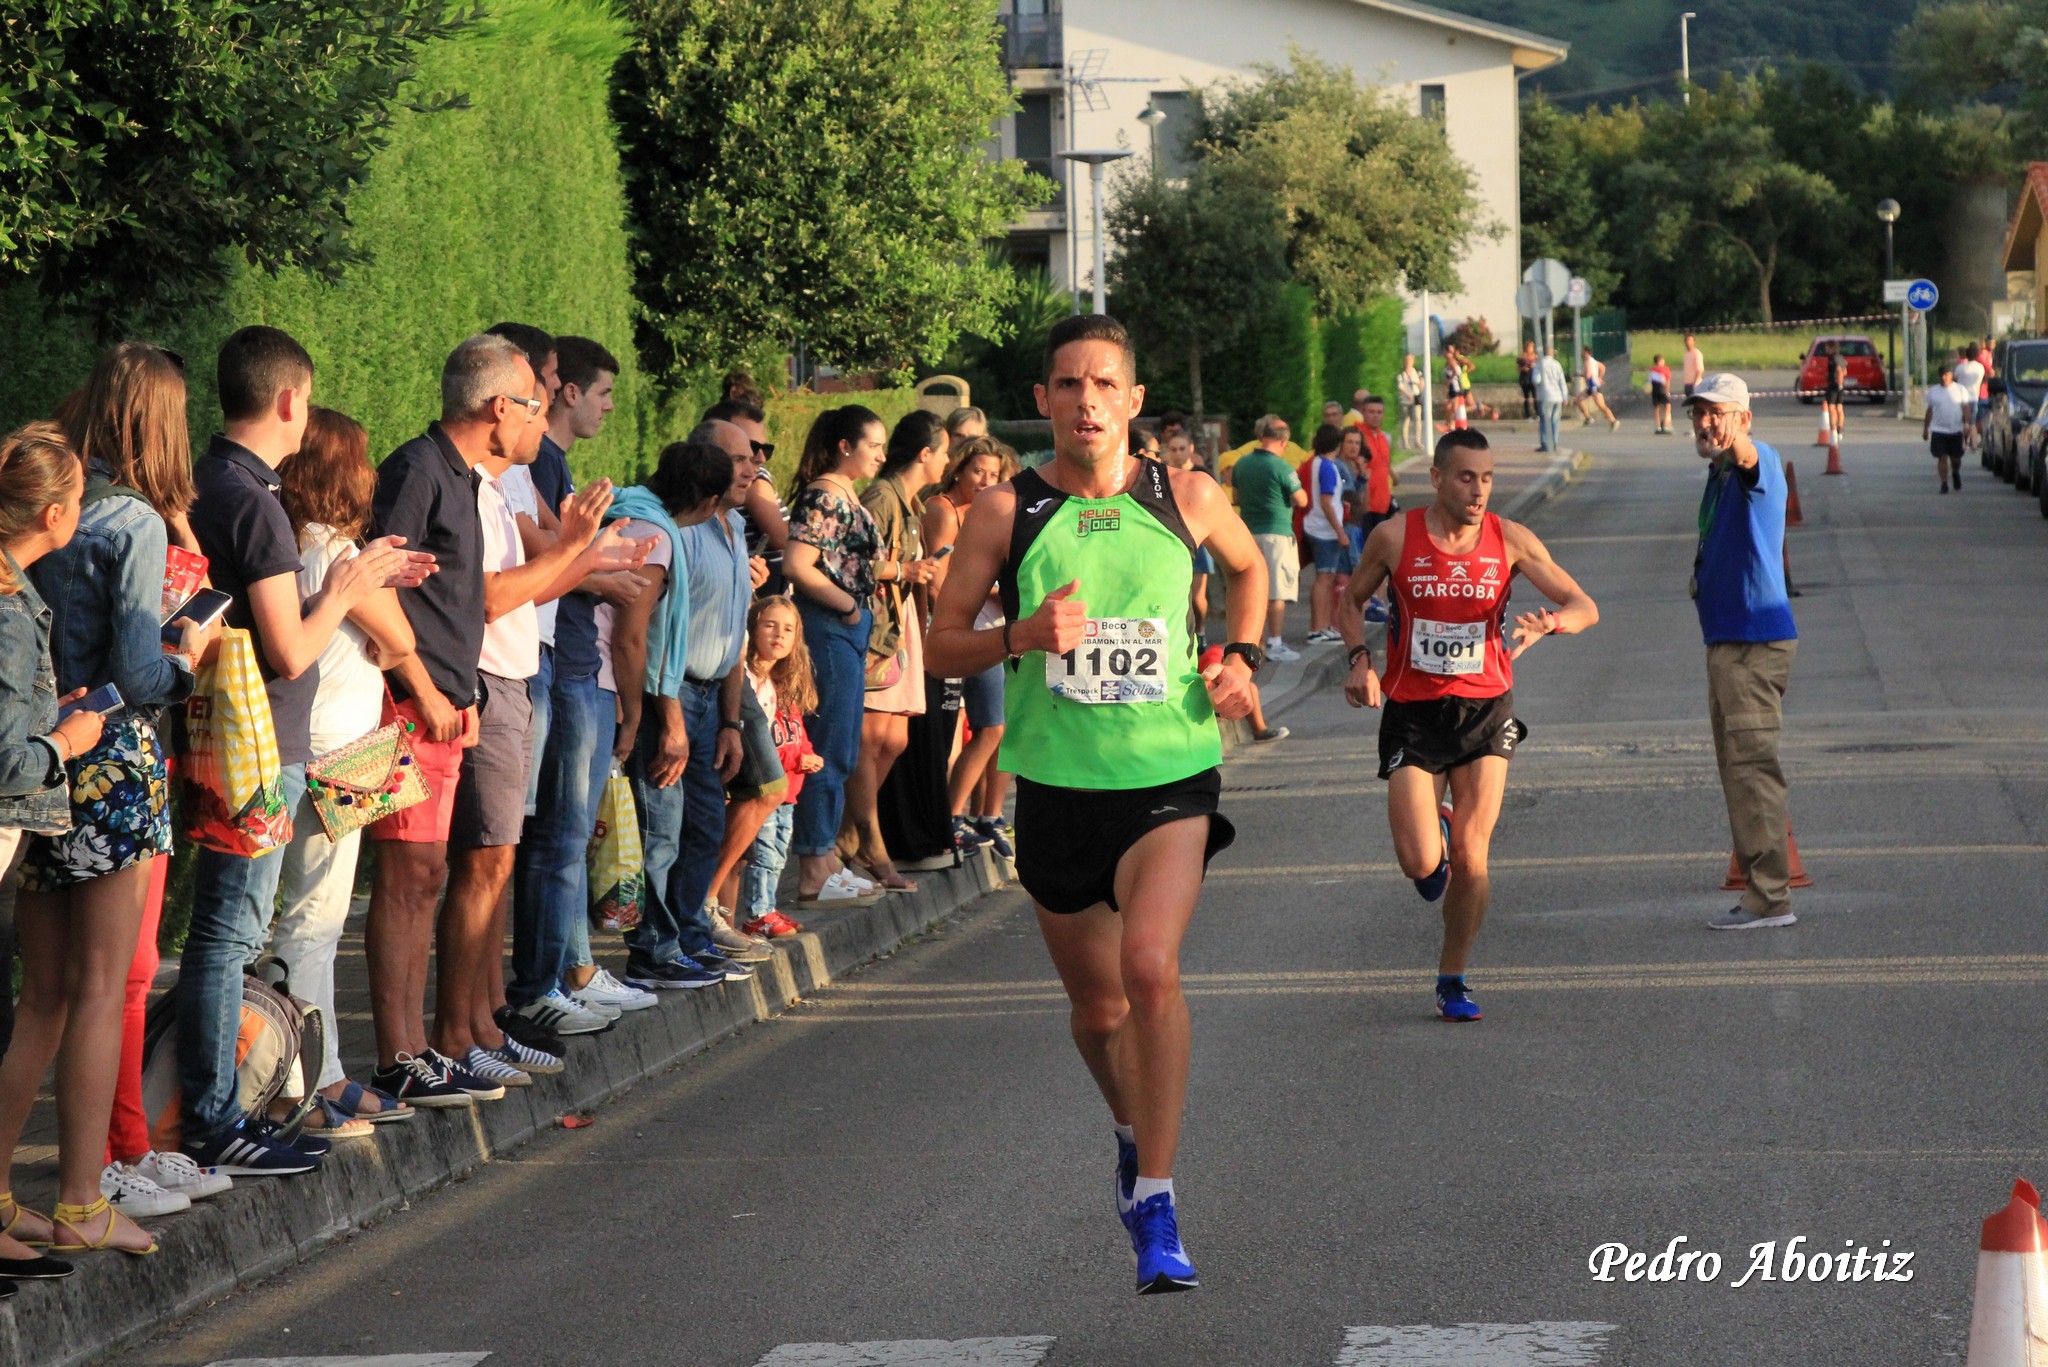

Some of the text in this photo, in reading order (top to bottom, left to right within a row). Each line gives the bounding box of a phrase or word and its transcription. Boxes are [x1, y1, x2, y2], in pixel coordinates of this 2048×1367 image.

[1151, 465, 1163, 499] CAYON
[1412, 583, 1496, 600] CARCOBA
[1101, 621, 1128, 630] Beco
[1419, 638, 1476, 658] 1001
[1060, 648, 1158, 676] 1102
